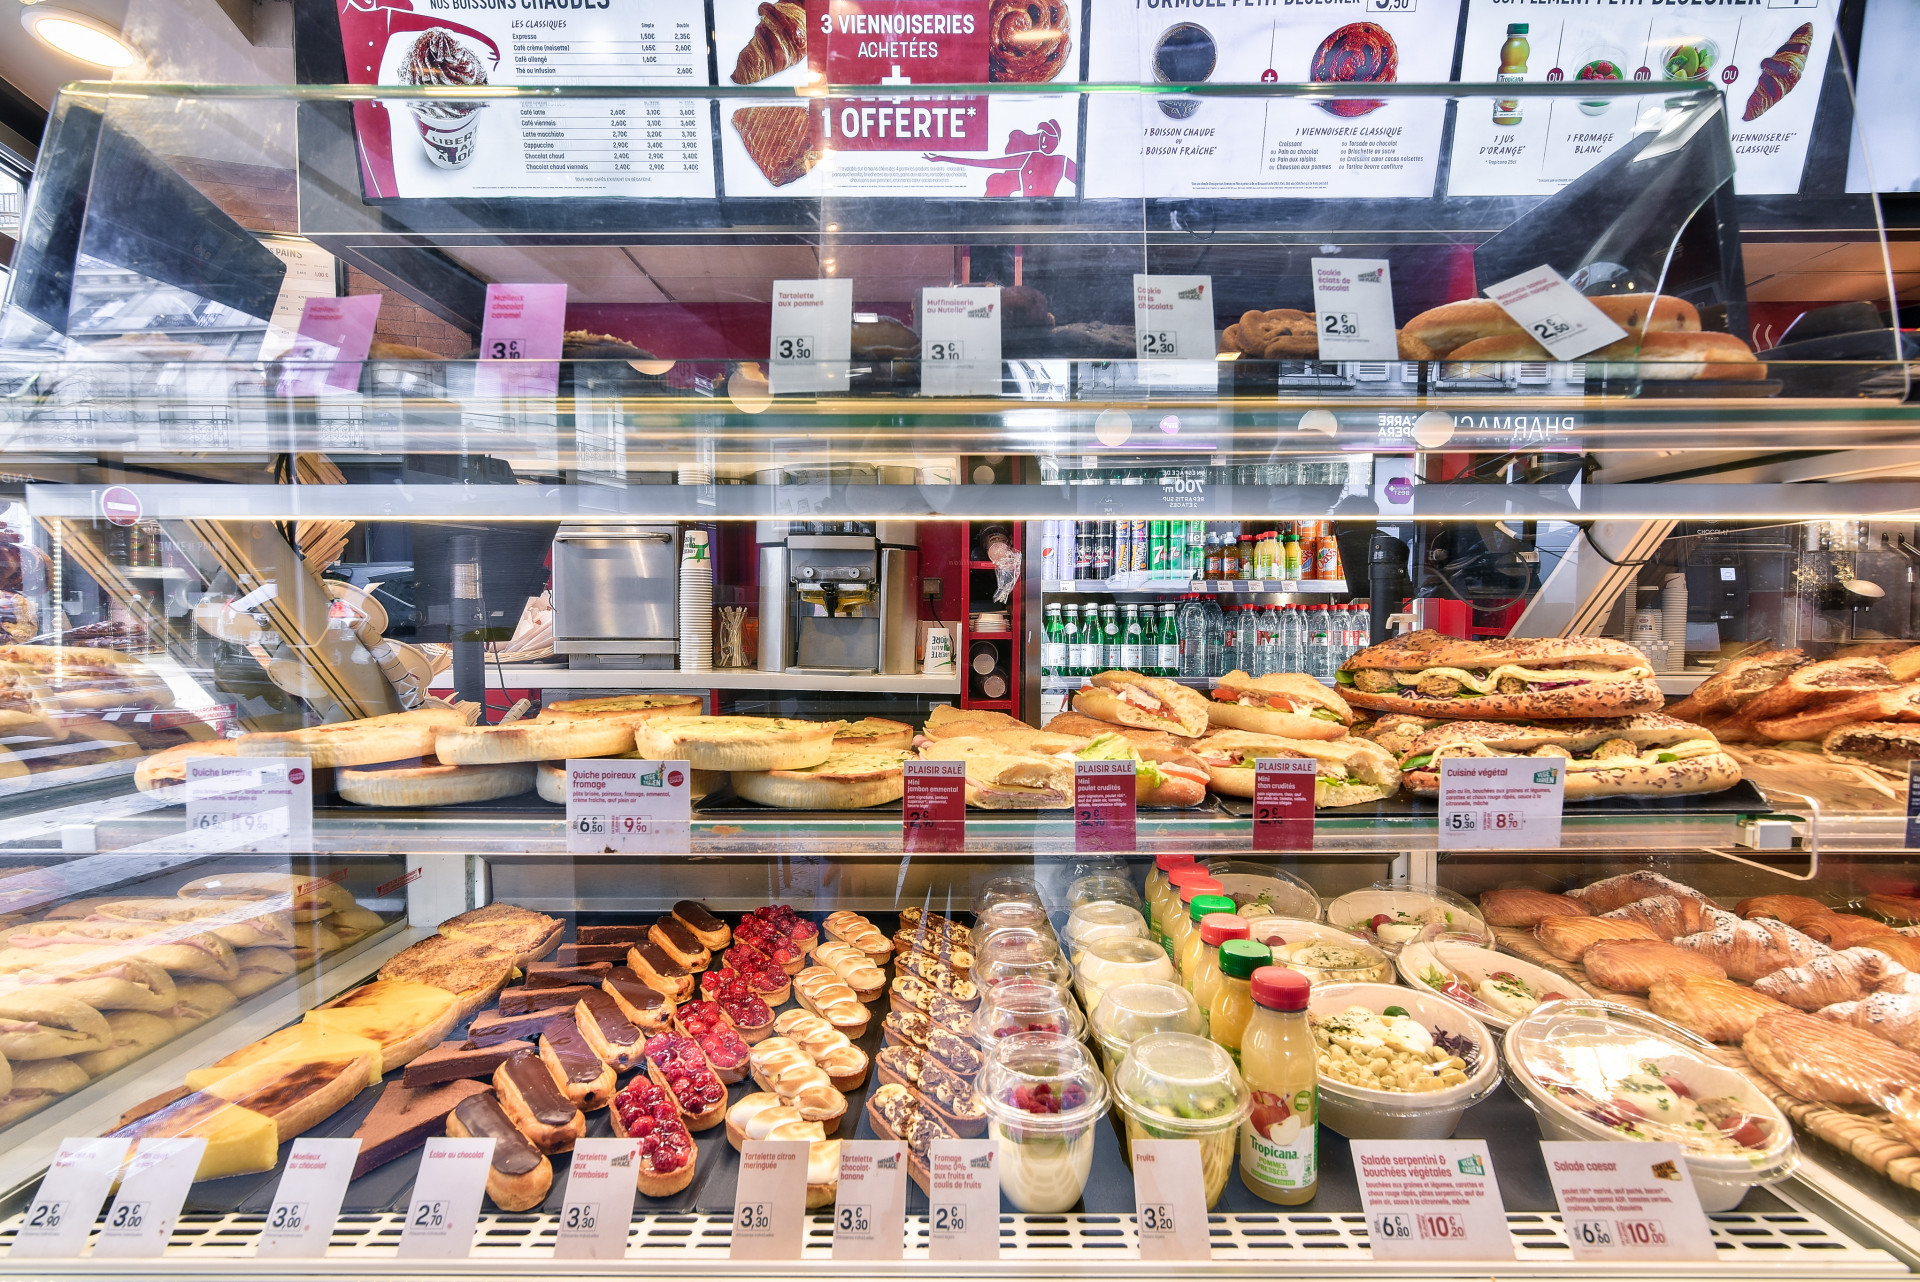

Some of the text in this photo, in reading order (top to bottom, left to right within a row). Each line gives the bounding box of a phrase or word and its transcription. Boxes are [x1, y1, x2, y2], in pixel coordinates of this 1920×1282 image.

[511, 19, 567, 30] LES CLASSIQUES
[821, 14, 975, 35] 3 VIENNOISERIES
[512, 33, 537, 41] Expresso
[675, 44, 692, 52] 2,60€
[857, 37, 938, 58] ACHETÉES
[527, 56, 548, 64] allongé
[677, 67, 693, 75] 2,60€
[1723, 70, 1737, 80] OU
[821, 107, 832, 138] 1
[1150, 127, 1182, 136] BOISSON
[1183, 127, 1216, 136] CHAUDE
[1301, 127, 1359, 136] VIENNOISERIE
[1360, 126, 1403, 138] CLASSIQUE
[1499, 134, 1515, 145] JUS
[1572, 133, 1615, 144] FROMAGE
[523, 142, 554, 150] Cappuccino
[1145, 146, 1178, 155] BOISSON
[1574, 146, 1603, 154] BLANC
[1735, 145, 1780, 155] CLASSIQUE
[274, 246, 303, 259] PAINS
[1317, 268, 1342, 277] Cookie
[1318, 276, 1351, 285] éclats de
[1137, 286, 1161, 295] Cookie
[1318, 284, 1350, 292] chocolat
[778, 292, 815, 300] Tartelette
[1137, 294, 1154, 303] trois
[491, 301, 525, 310] chocolat
[778, 299, 824, 309] aux pommes
[927, 299, 974, 307] Muffinoiserie
[1138, 302, 1174, 311] chocolats
[490, 310, 522, 319] caramel
[908, 764, 963, 775] PLAISIR SALÉ
[1077, 762, 1132, 774] PLAISIR SALÉ
[1258, 761, 1313, 772] PLAISIR SALÉ
[191, 768, 220, 778] Quiche
[572, 770, 637, 782] Quiche poireaux
[1447, 767, 1508, 779] Cuisiné végétal
[572, 779, 606, 791] fromage
[907, 785, 959, 794] jambon emmental
[1077, 784, 1121, 793] poulet crudités
[1249, 1134, 1300, 1160] Tropicana
[428, 1149, 447, 1158] Éclair
[456, 1150, 484, 1159] chocolat
[576, 1152, 608, 1161] Tartelette
[743, 1152, 796, 1161] Tartelette citron
[842, 1154, 873, 1163] Tartelette
[1136, 1154, 1156, 1162] Fruits
[934, 1154, 963, 1165] Fromage
[1258, 1156, 1288, 1170] POMMES
[1360, 1154, 1447, 1167] Salade serpentini &
[299, 1161, 327, 1169] chocolat
[743, 1161, 777, 1171] meringuée
[841, 1163, 871, 1172] chocolat-
[934, 1163, 967, 1172] blanc 0%
[1553, 1160, 1617, 1171] Salade caesar
[572, 1170, 609, 1180] framboises
[840, 1172, 865, 1181] banane
[946, 1172, 974, 1180] fruits et
[1362, 1166, 1453, 1180] bouchées végétales
[934, 1180, 982, 1189] coulis de fruits
